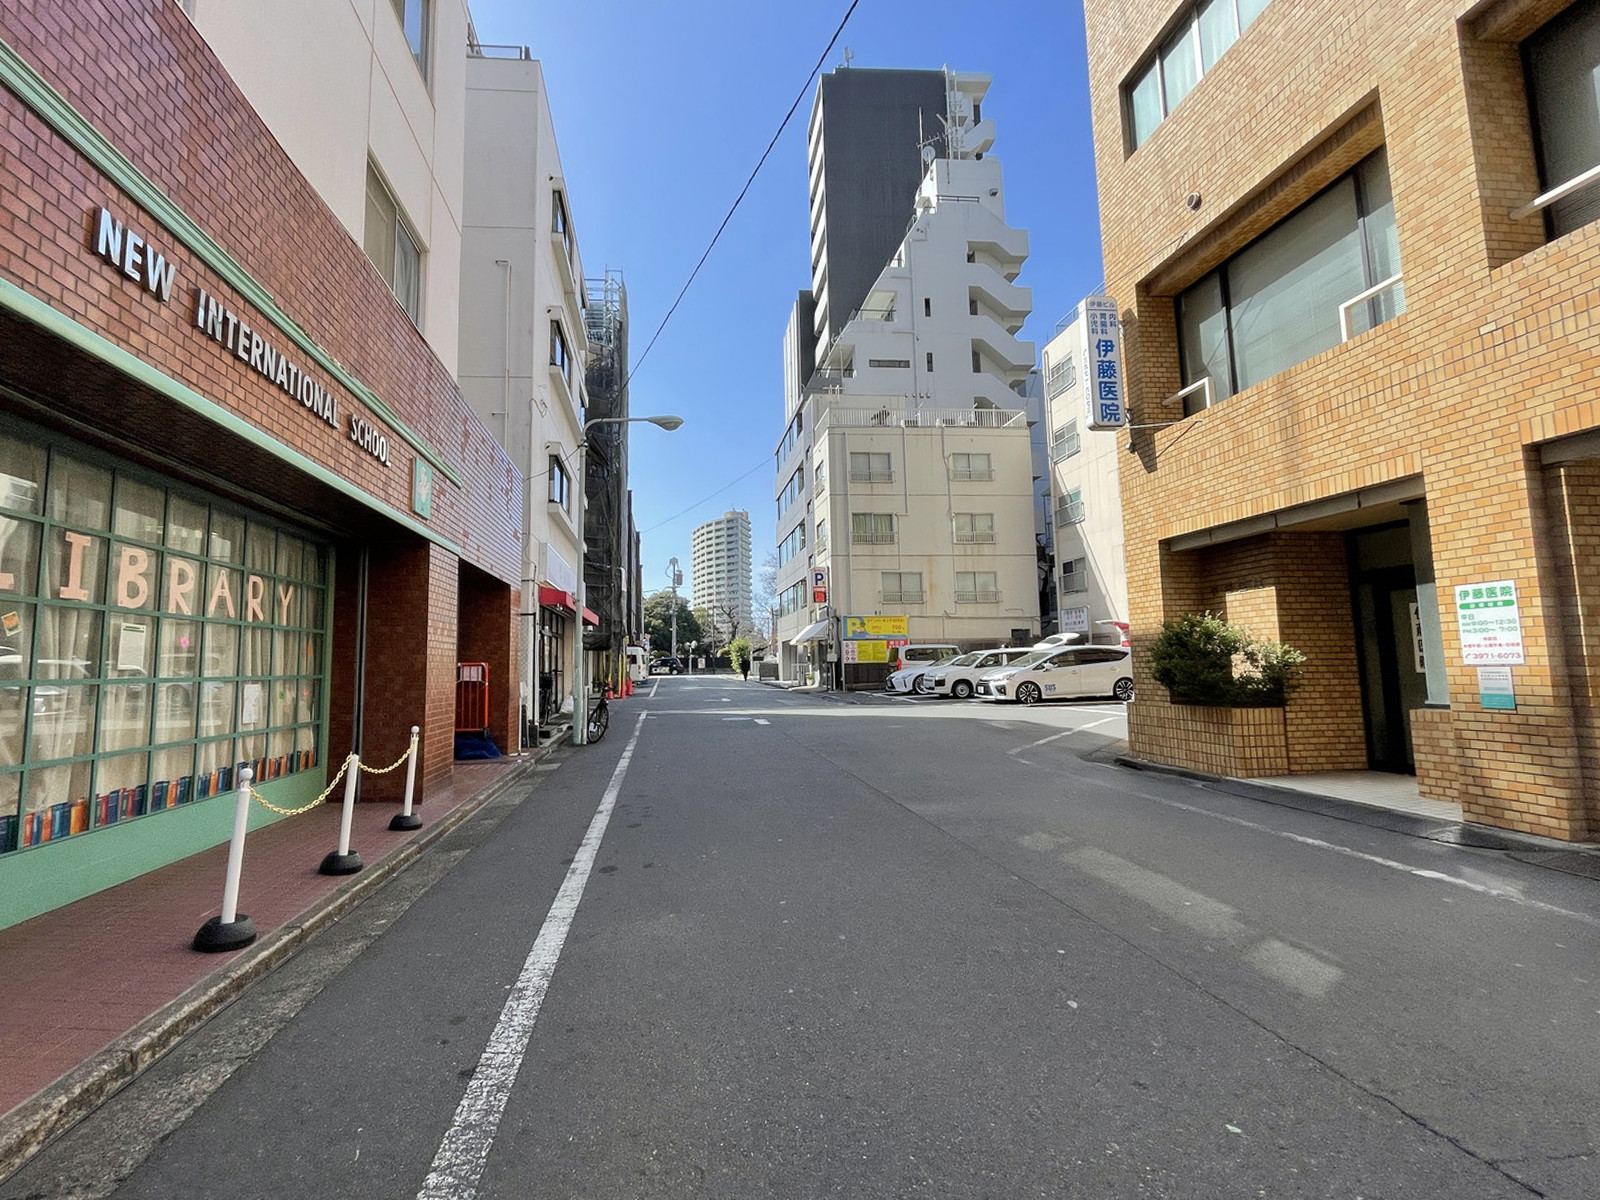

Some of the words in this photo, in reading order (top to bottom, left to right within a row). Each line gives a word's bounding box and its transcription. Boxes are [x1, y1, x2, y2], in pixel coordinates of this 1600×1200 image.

[1090, 312, 1099, 335] 小児科
[1109, 313, 1117, 328] 内科
[95, 206, 177, 303] NEW
[195, 288, 340, 430] INTERNATIONAL
[349, 412, 392, 468] SCHOOL
[1095, 338, 1121, 422] 伊藤医院
[815, 573, 824, 585] P
[1459, 586, 1513, 600] 伊藤医院
[847, 618, 860, 637] P
[1472, 652, 1521, 660] 3971-6073
